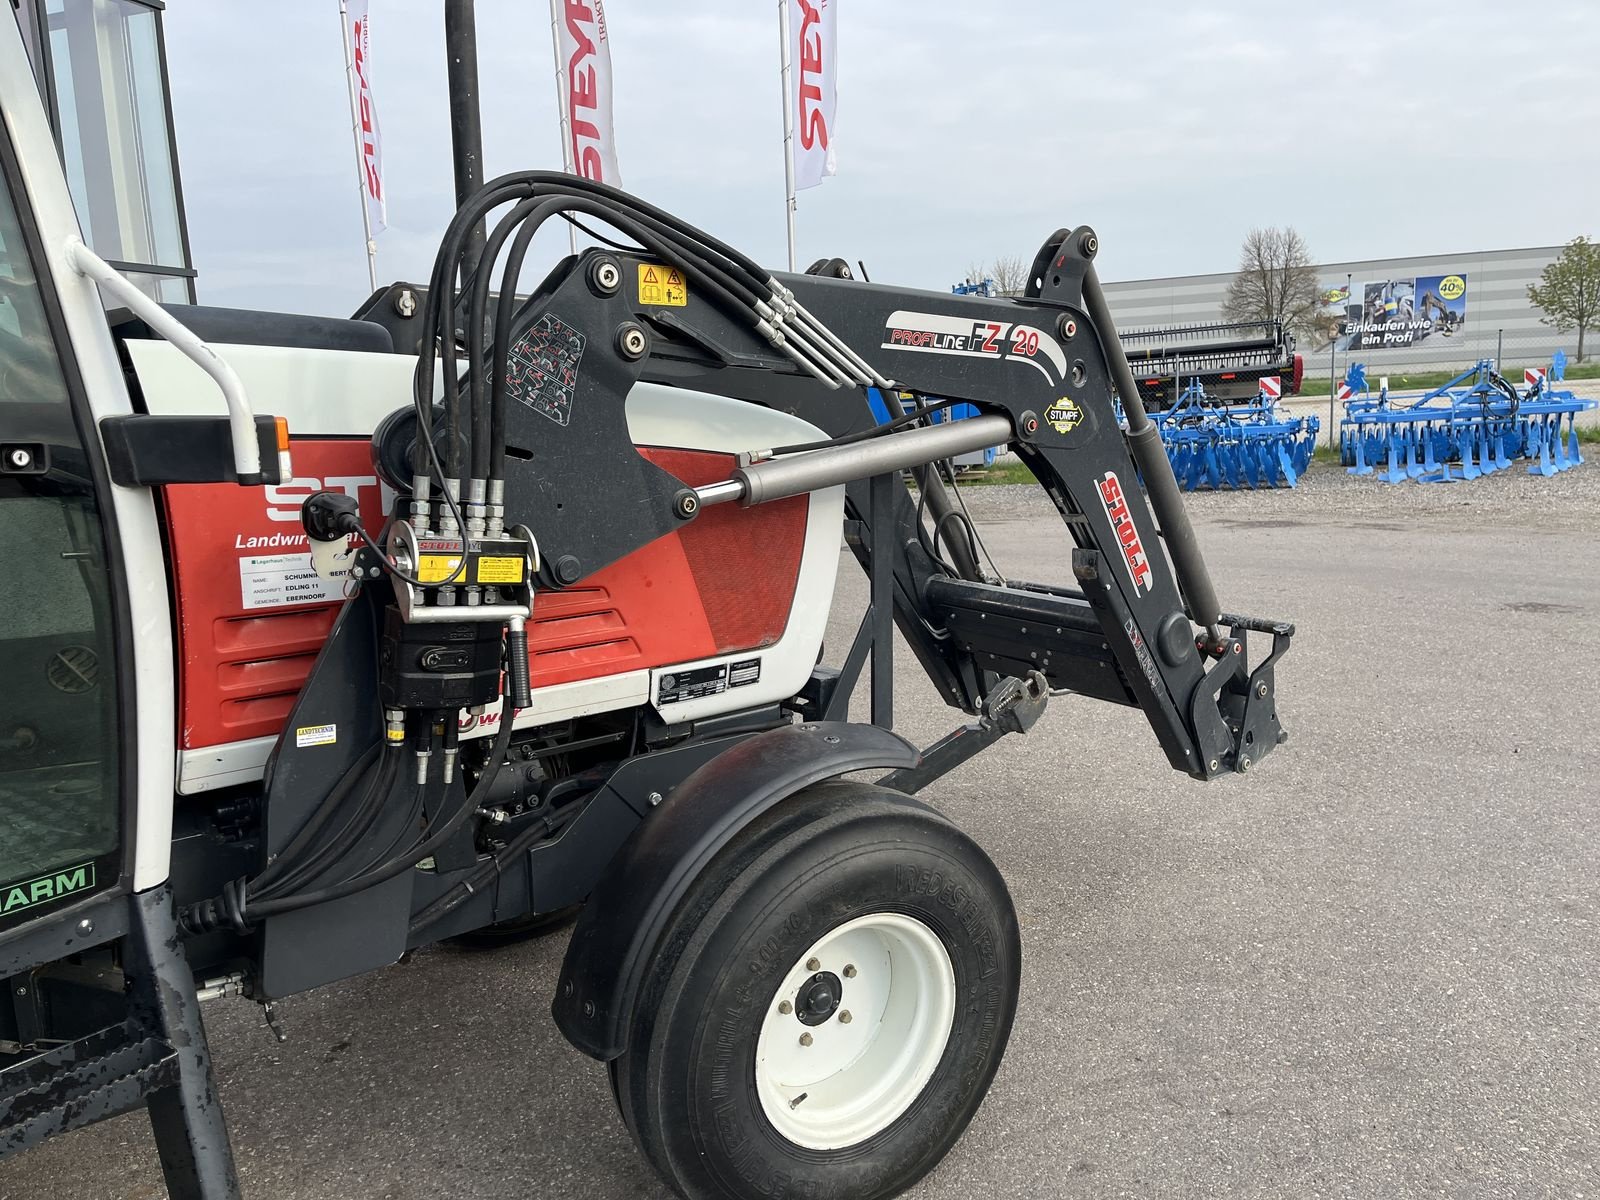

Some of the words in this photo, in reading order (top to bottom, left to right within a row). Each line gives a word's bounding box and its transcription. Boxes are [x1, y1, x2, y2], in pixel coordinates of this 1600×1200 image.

[1440, 282, 1464, 292] 40%
[1345, 319, 1406, 334] Einkaufen
[1409, 318, 1431, 330] wie
[891, 329, 966, 350] PROFILINE
[968, 322, 1002, 353] FZ
[1012, 329, 1039, 357] 20
[1361, 332, 1383, 345] ein
[1383, 331, 1414, 344] Profi
[1050, 410, 1078, 421] STUMPF
[1100, 477, 1149, 587] STOLL
[419, 541, 460, 550] STOLL
[286, 593, 326, 602] EBERNDORF
[0, 868, 86, 912] ARM
